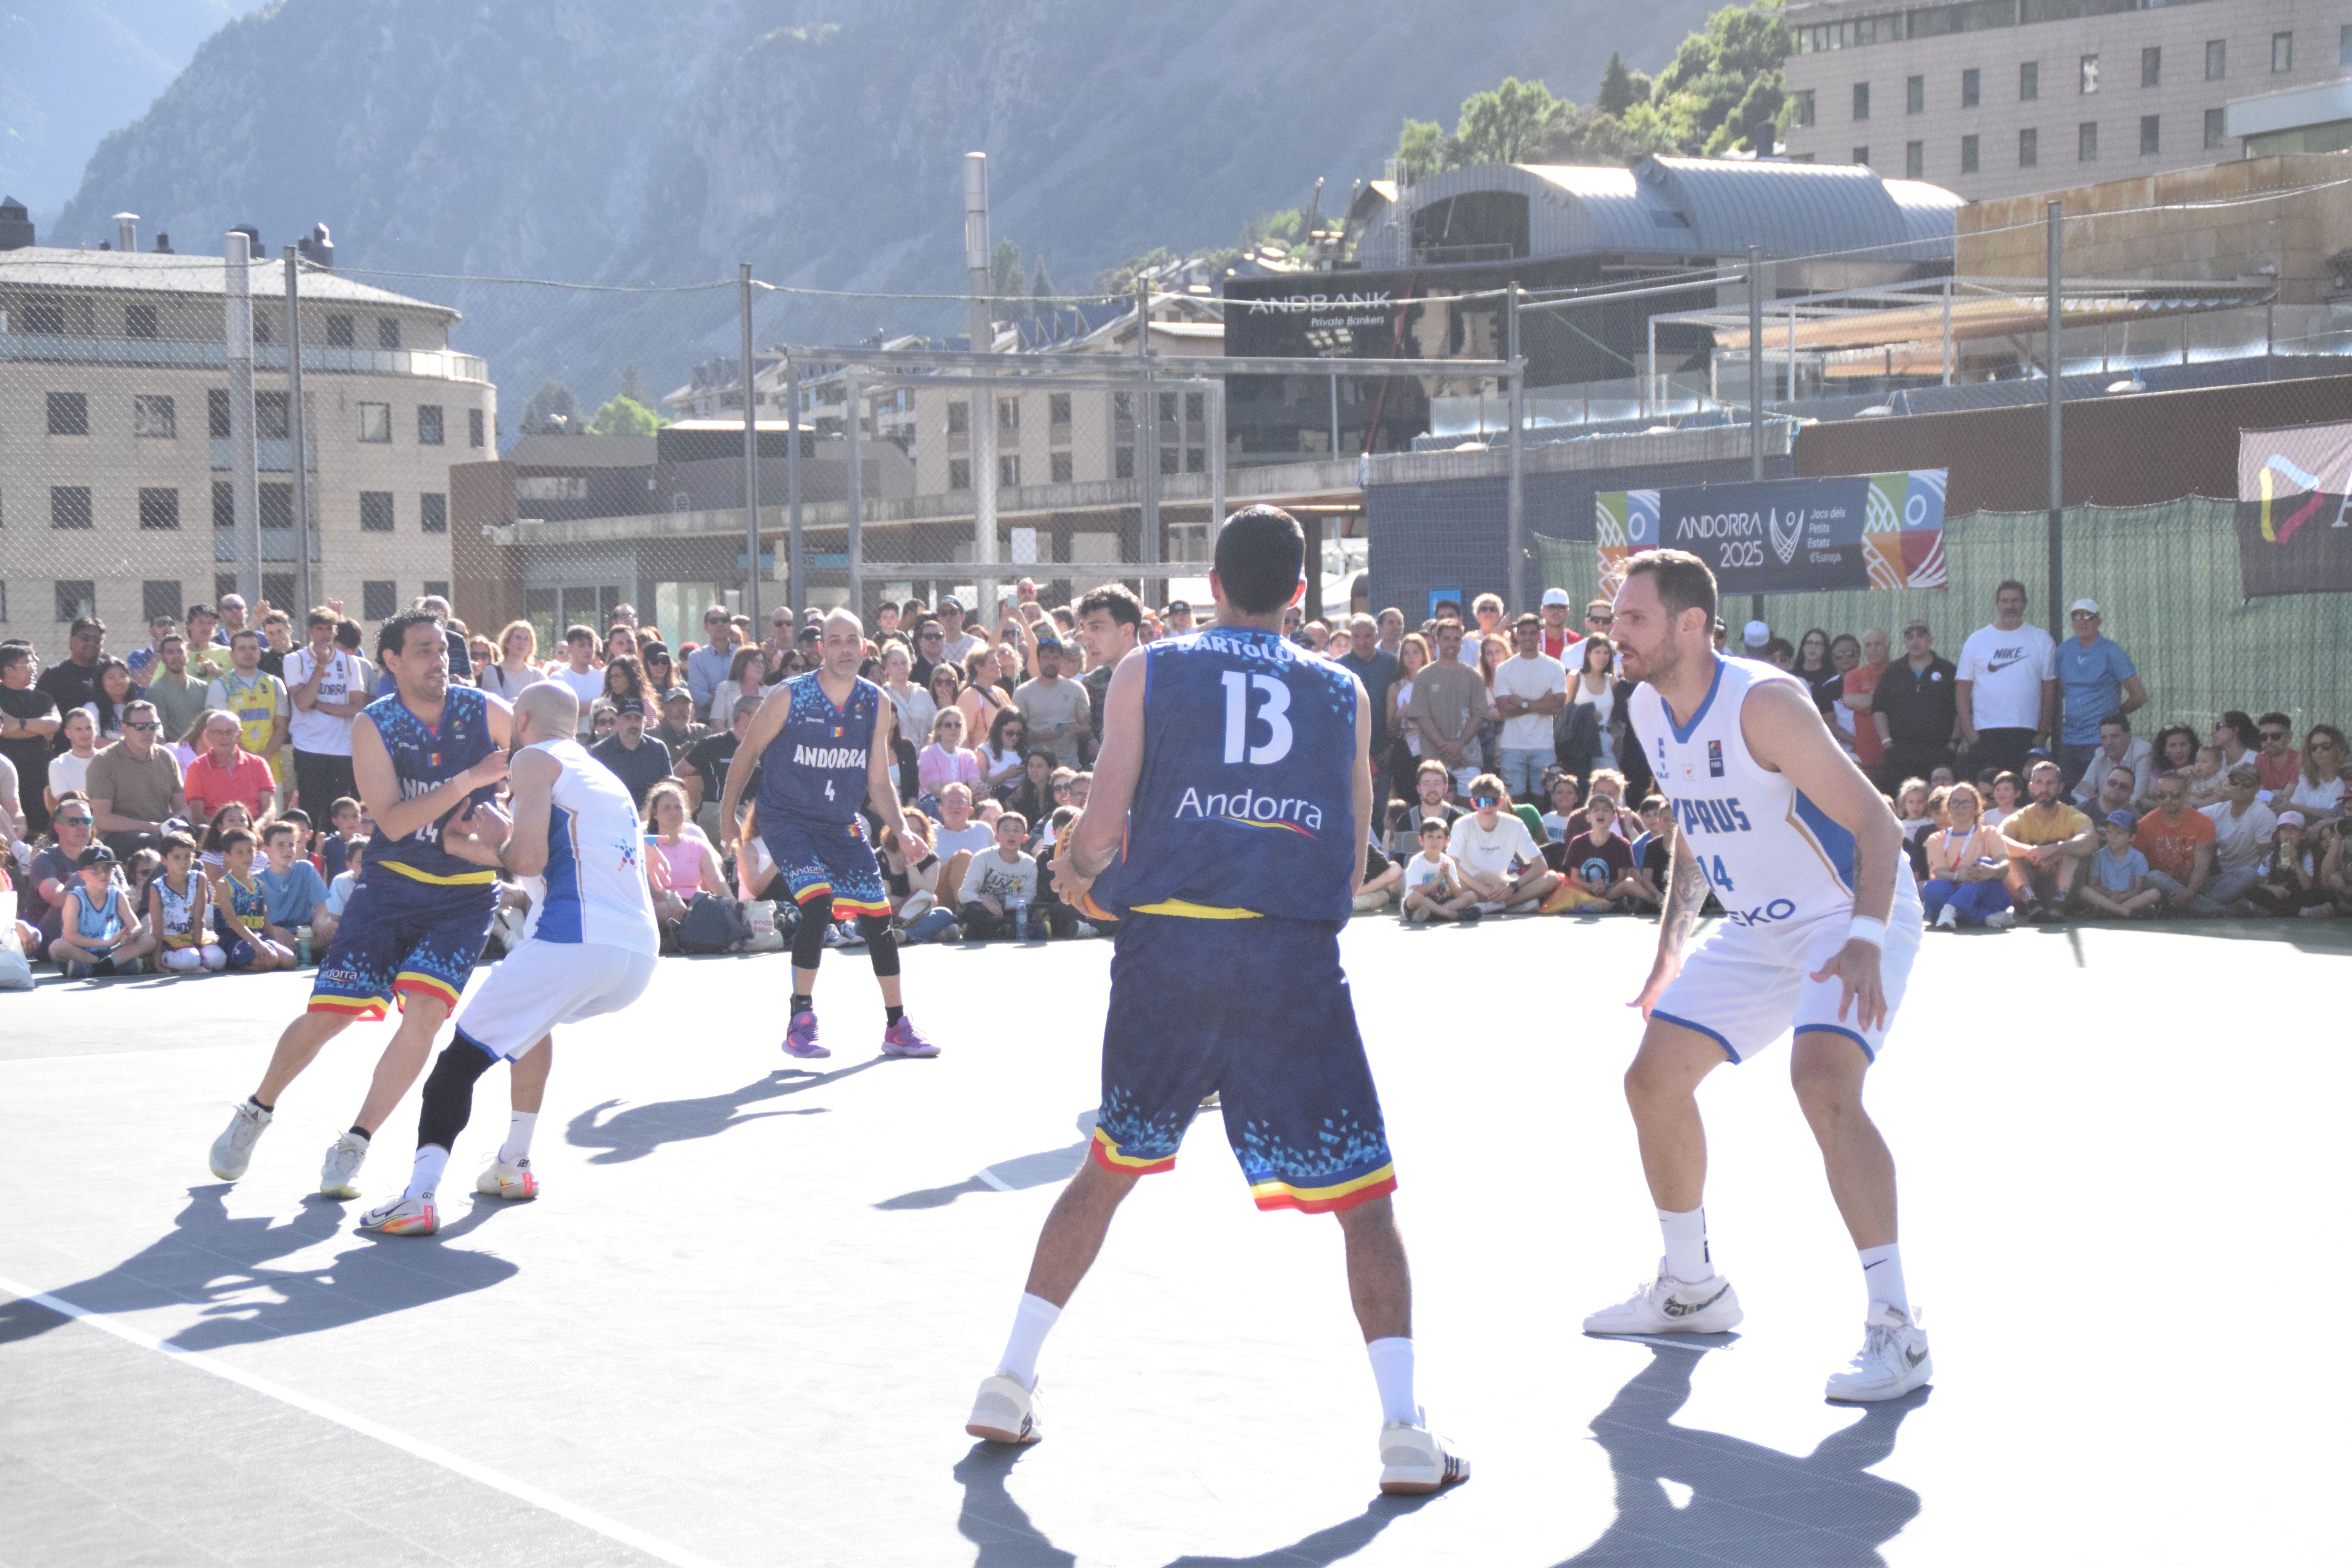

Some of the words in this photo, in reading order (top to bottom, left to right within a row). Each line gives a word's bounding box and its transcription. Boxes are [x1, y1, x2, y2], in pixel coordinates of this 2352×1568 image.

[1249, 291, 1390, 314] ANDBANK
[1311, 317, 1344, 327] Private
[1347, 315, 1384, 325] Bankers
[1811, 509, 1829, 519] Jocs
[1830, 507, 1846, 518] dels
[1676, 512, 1763, 539] ANDORRA
[1809, 523, 1830, 534] Petits
[1808, 537, 1830, 548] Estats
[1720, 541, 1764, 567] 2025
[1809, 552, 1842, 564] d'Europa
[1177, 633, 1305, 666] BARTOLO
[1993, 646, 2024, 659] NIKE
[1221, 670, 1293, 765] 13
[793, 744, 866, 769] ANDORRA
[824, 780, 835, 801] 4
[1175, 787, 1323, 830] Andorra
[1696, 855, 1735, 892] 14
[324, 968, 358, 980] dorra
